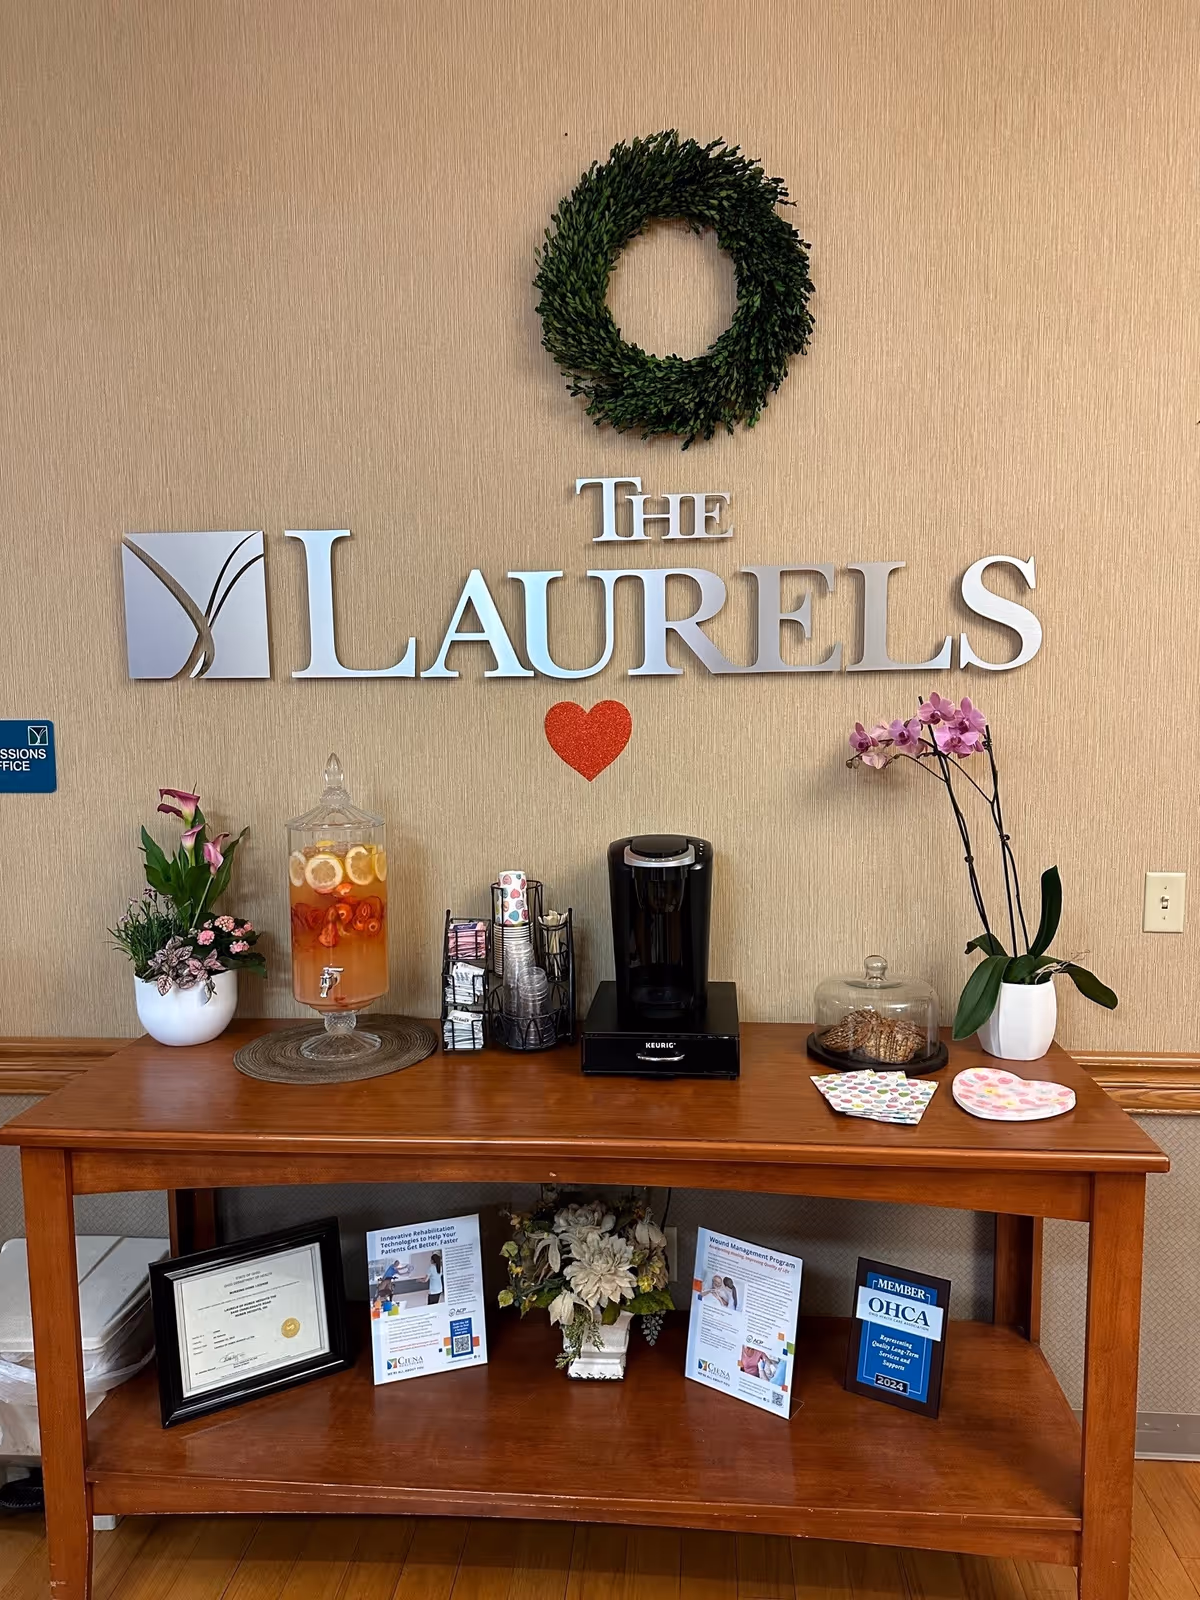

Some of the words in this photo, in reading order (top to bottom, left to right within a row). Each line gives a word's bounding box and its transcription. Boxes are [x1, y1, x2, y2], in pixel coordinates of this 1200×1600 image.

[575, 476, 735, 543] THE
[284, 528, 1043, 680] LAURELS
[380, 1231, 412, 1242] Innovative
[413, 1225, 455, 1237] Rehabilitation
[380, 1237, 419, 1249] Technologies
[427, 1233, 441, 1242] Help
[442, 1231, 457, 1240] Your
[381, 1246, 406, 1255] Patients
[418, 1241, 440, 1250] Better,
[440, 1237, 459, 1246] Faster
[709, 1235, 730, 1249] Wound
[730, 1242, 769, 1261] Management
[769, 1255, 796, 1269] Program
[877, 1278, 926, 1300] MEMBER
[868, 1296, 930, 1328] OHCA
[893, 1317, 903, 1325] CARE
[871, 1340, 891, 1351] Quality
[891, 1345, 920, 1359] Long-Term
[880, 1334, 913, 1349] Representing
[397, 1355, 424, 1365] CIENA
[879, 1350, 900, 1361] Services
[882, 1359, 905, 1371] Supports
[877, 1376, 904, 1391] 2024
